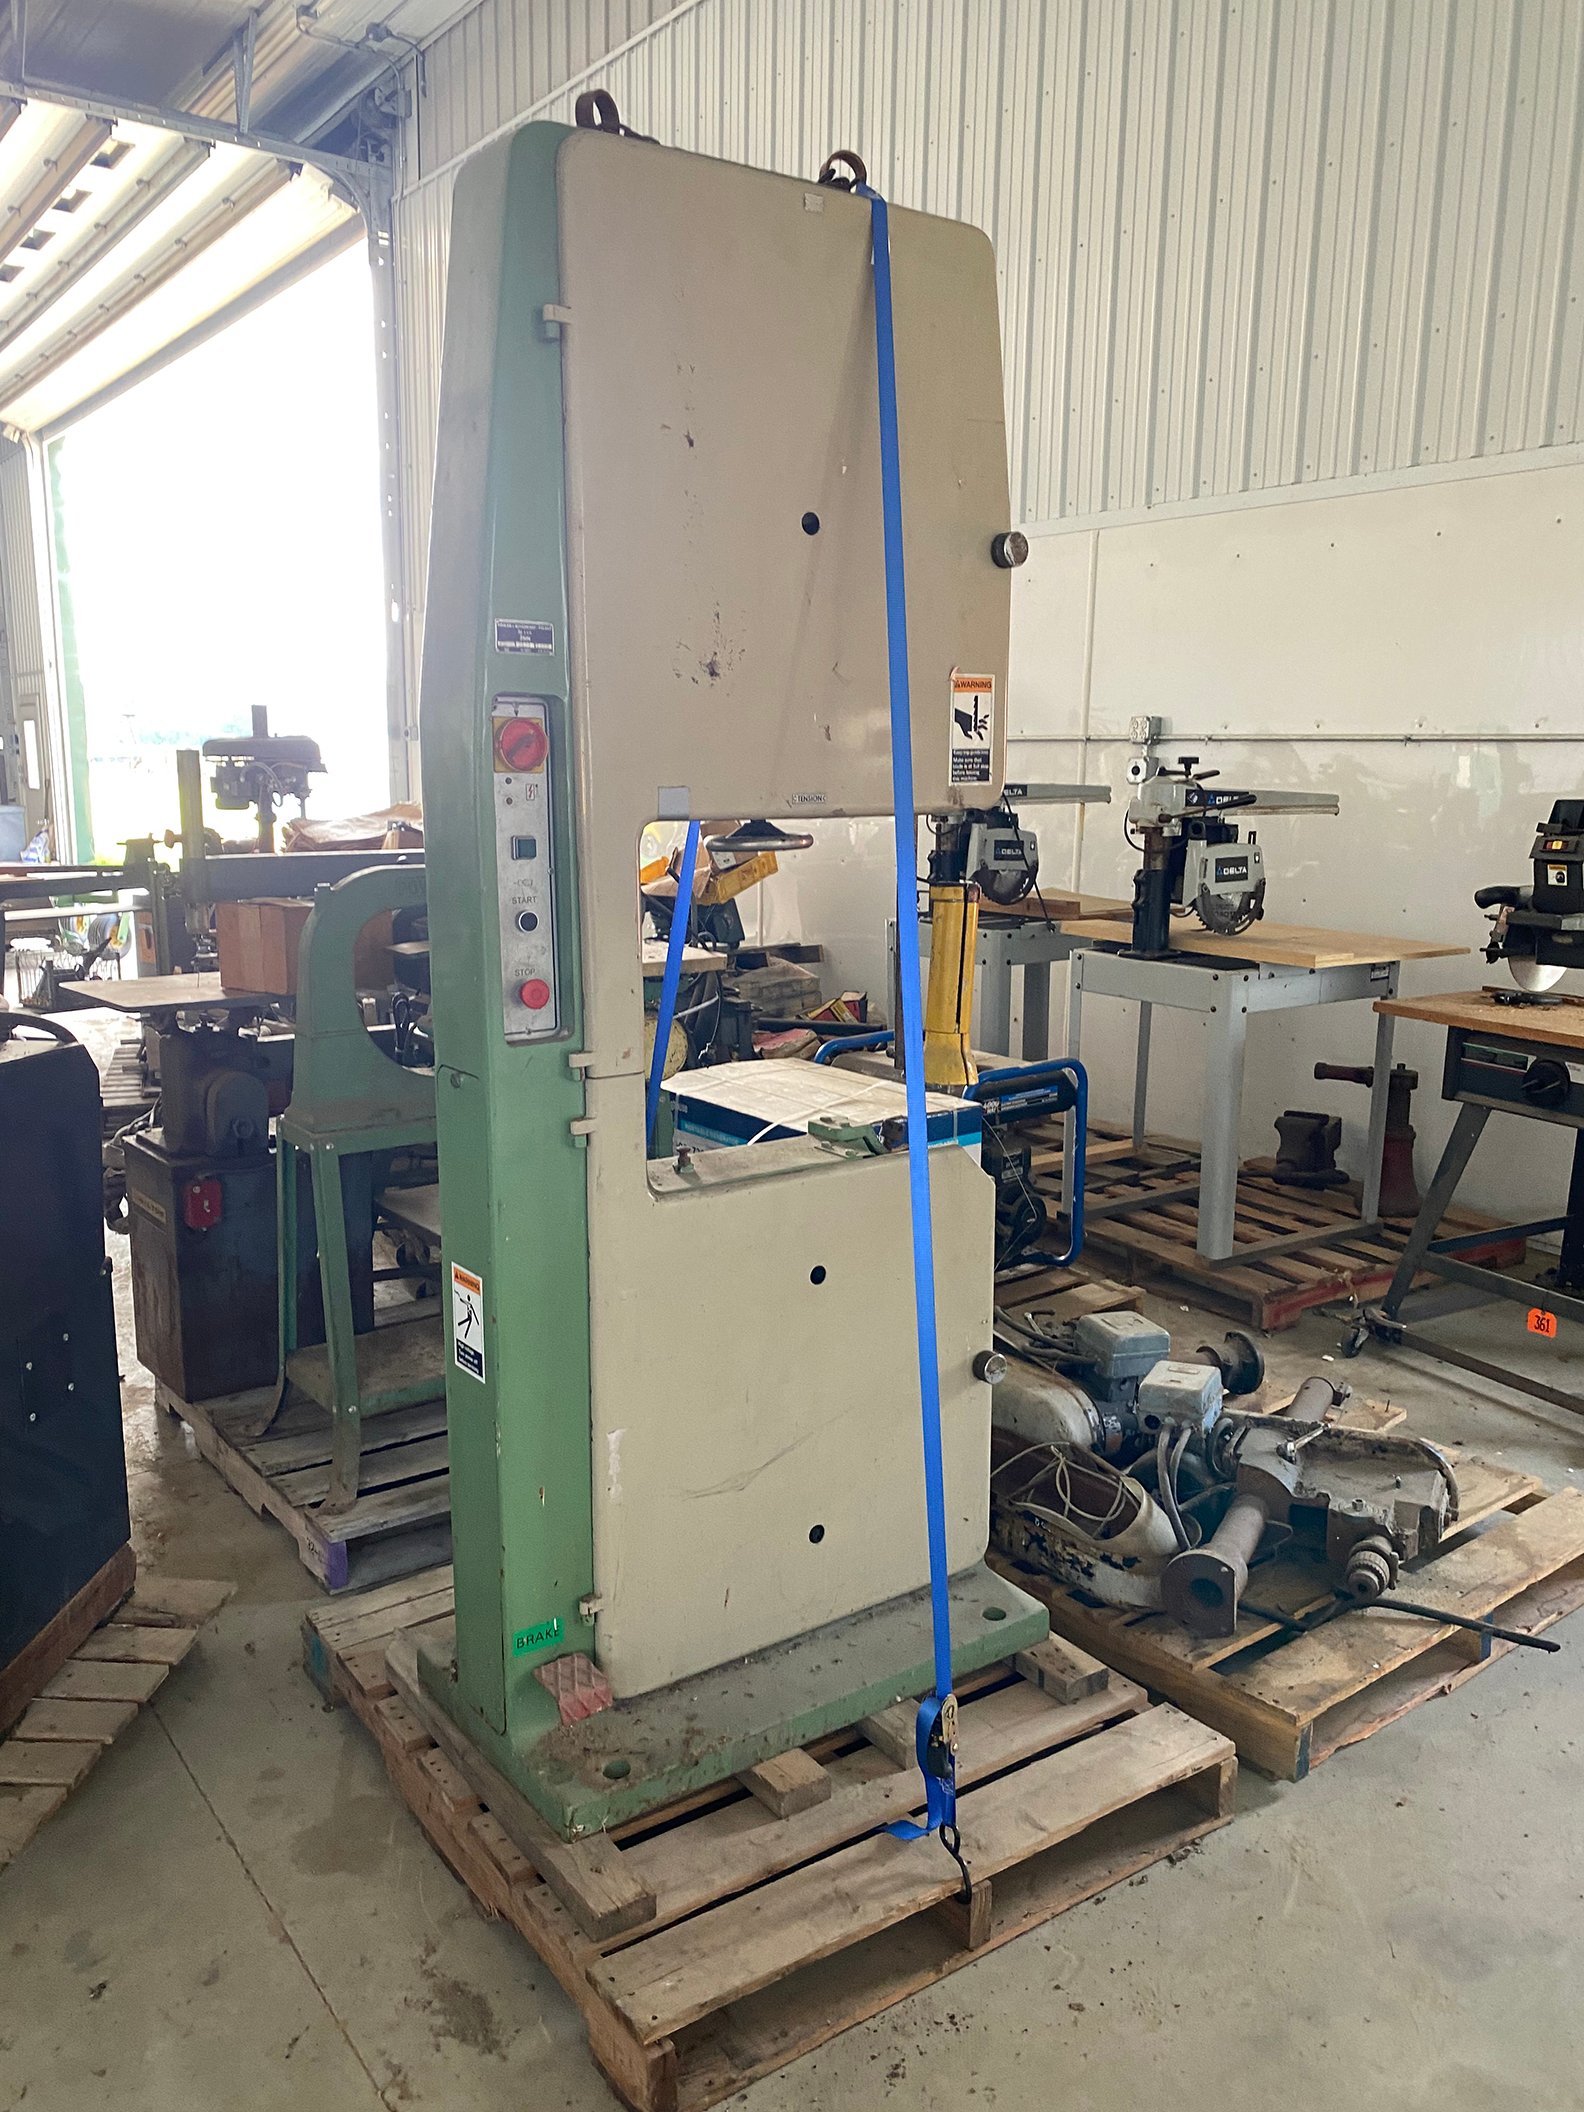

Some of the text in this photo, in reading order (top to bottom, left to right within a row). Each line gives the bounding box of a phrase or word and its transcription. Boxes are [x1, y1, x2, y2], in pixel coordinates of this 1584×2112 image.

[960, 680, 992, 689] WARNING
[1003, 788, 1023, 796] ELTA
[1223, 866, 1248, 876] DELTA
[511, 895, 538, 905] START
[514, 968, 536, 977] STOP
[1533, 1314, 1551, 1333] 361
[516, 1625, 560, 1649] BRAKE
